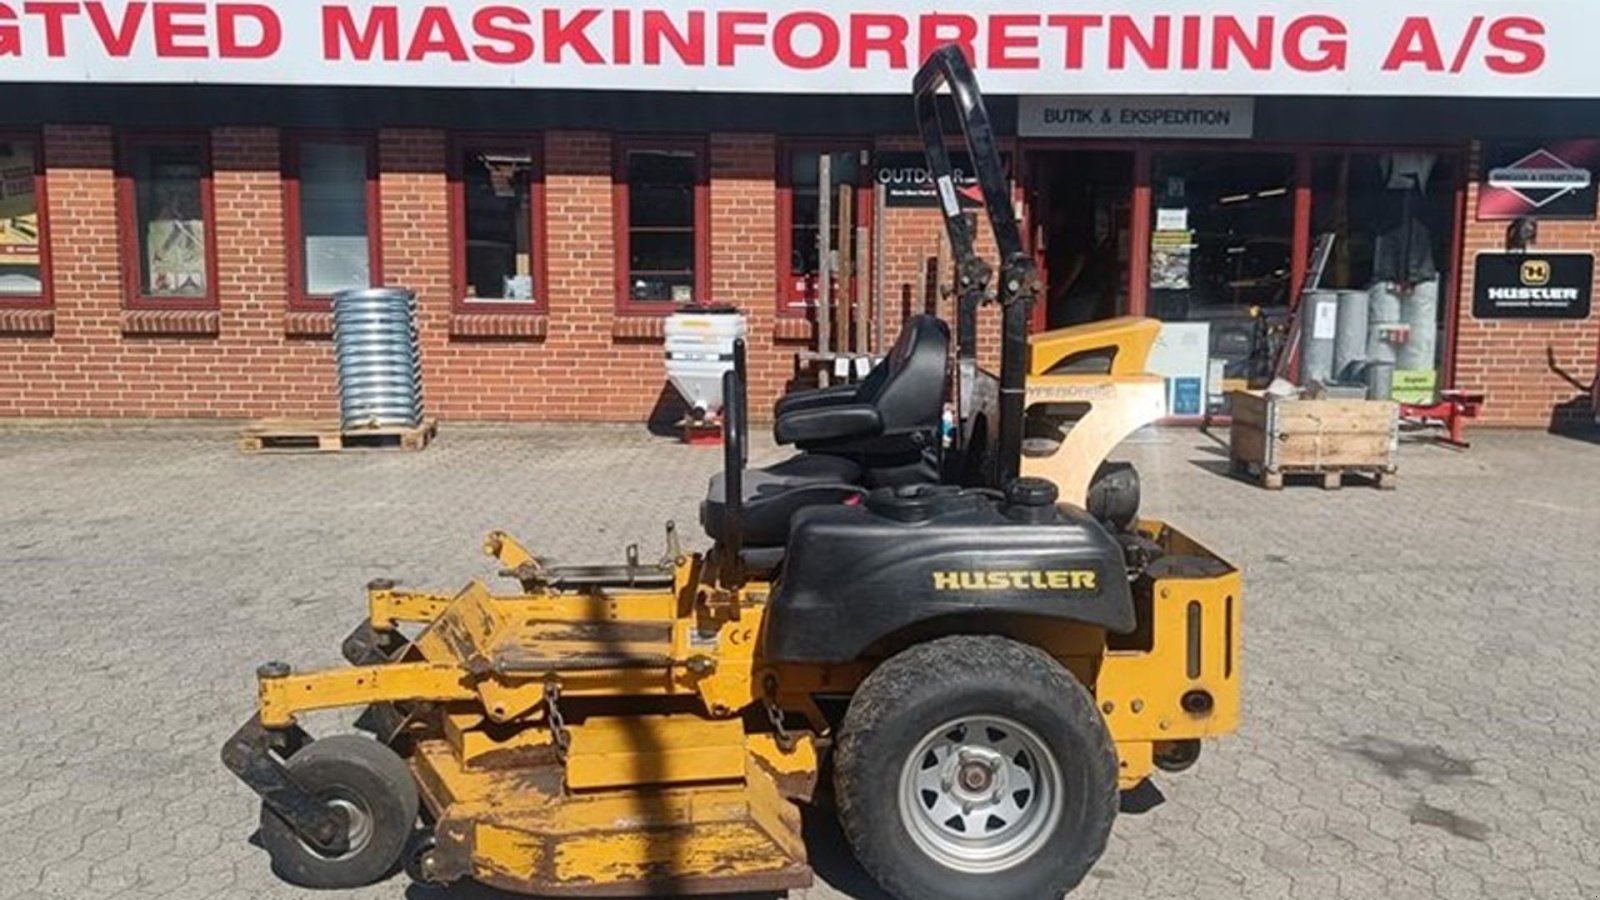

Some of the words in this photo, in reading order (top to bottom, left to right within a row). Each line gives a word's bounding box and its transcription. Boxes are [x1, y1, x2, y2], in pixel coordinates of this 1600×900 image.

[322, 5, 1348, 72] MASKINFORRETNING
[1381, 16, 1546, 75] A/S
[1044, 108, 1093, 125] BUTIK
[1100, 108, 1112, 124] &
[1120, 109, 1231, 126] EKSPEDITION
[1488, 288, 1578, 300] HUSTLER
[933, 570, 1096, 590] HUSTLER
